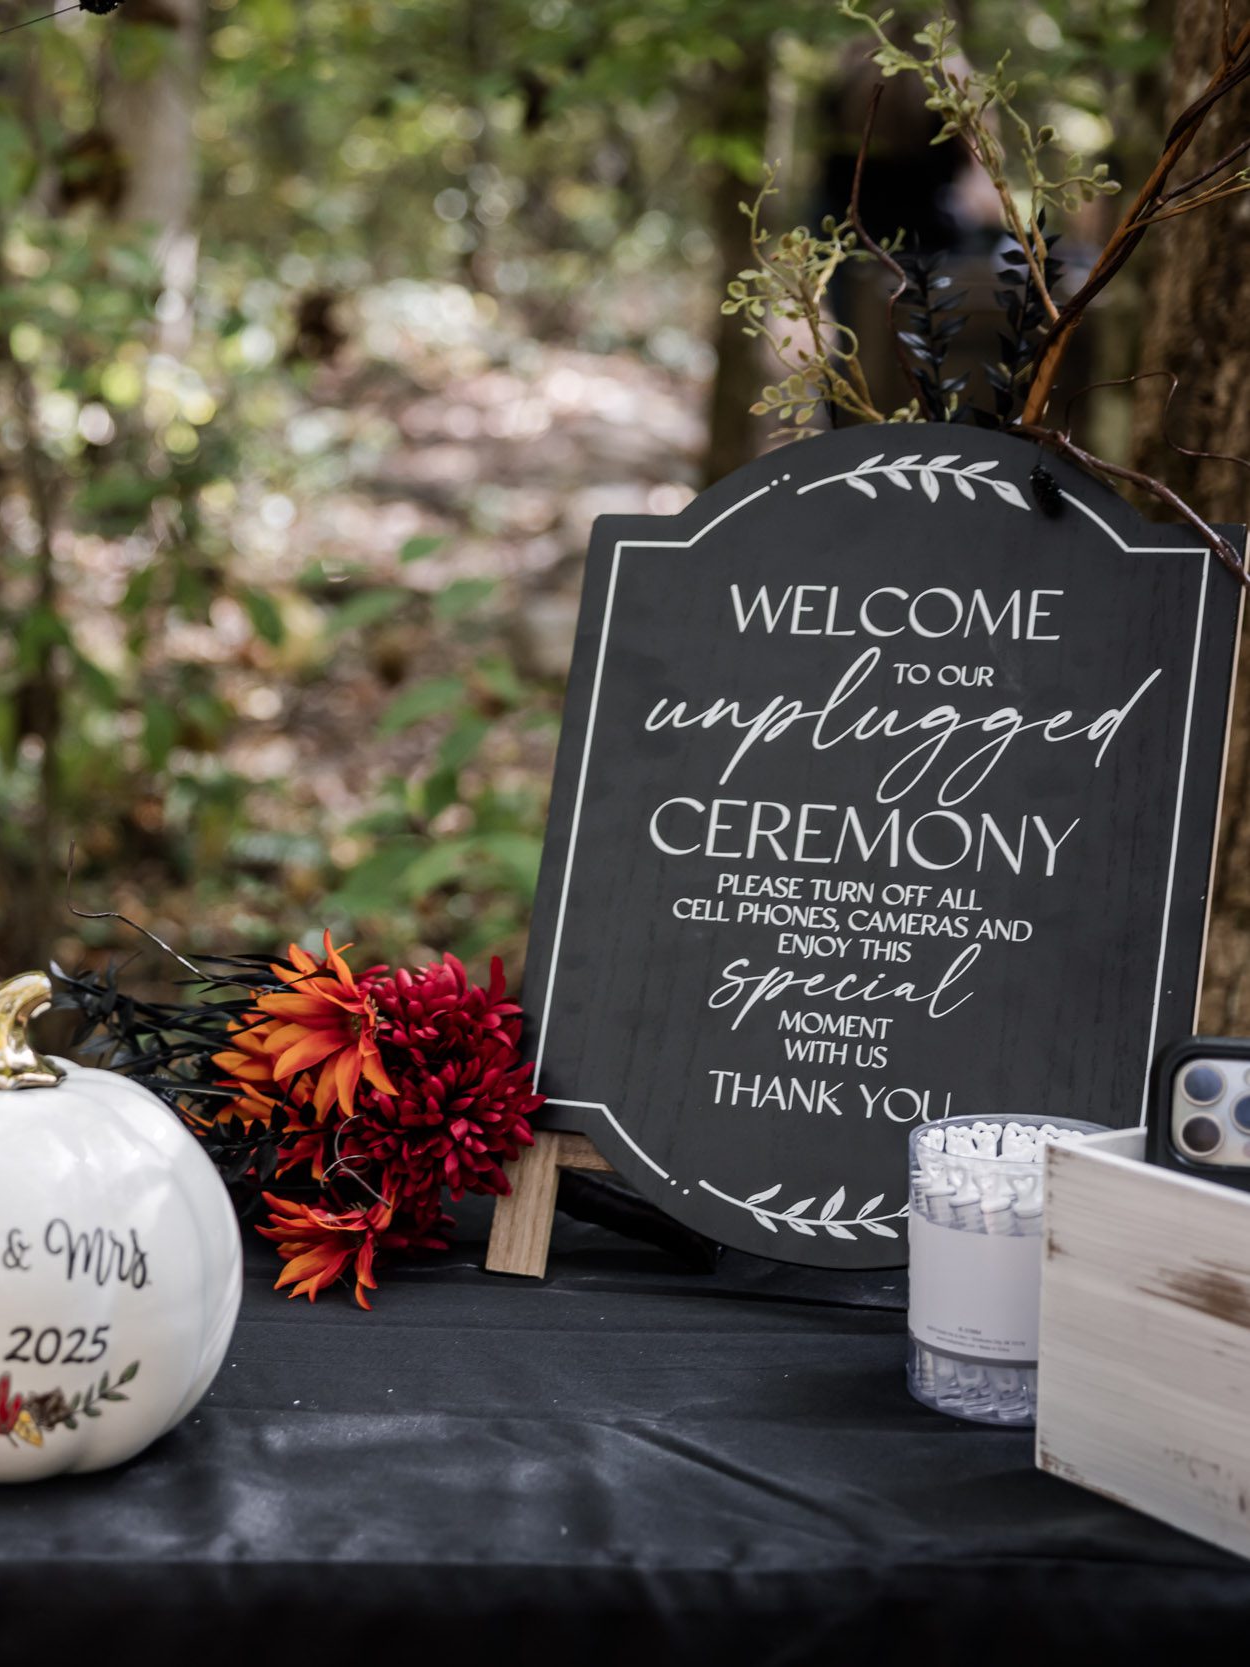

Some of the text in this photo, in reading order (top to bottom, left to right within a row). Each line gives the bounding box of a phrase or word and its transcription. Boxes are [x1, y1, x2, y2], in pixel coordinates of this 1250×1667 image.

[730, 583, 1064, 640] WELCOME
[893, 663, 995, 688] TO OUR
[645, 646, 1162, 807] unplugged
[649, 796, 1081, 877] CEREMONY
[717, 873, 983, 912] PLEASE TURN OFF ALL
[672, 897, 1034, 943] CELL PHONES, CAMERAS AND
[777, 932, 913, 963] ENJOY THIS
[708, 943, 982, 1031] special
[777, 1009, 893, 1040] MOMENT
[784, 1038, 888, 1069] WITH US
[708, 1069, 952, 1123] THANK YOU
[2, 1228, 31, 1272] &
[3, 1324, 112, 1365] 2025
